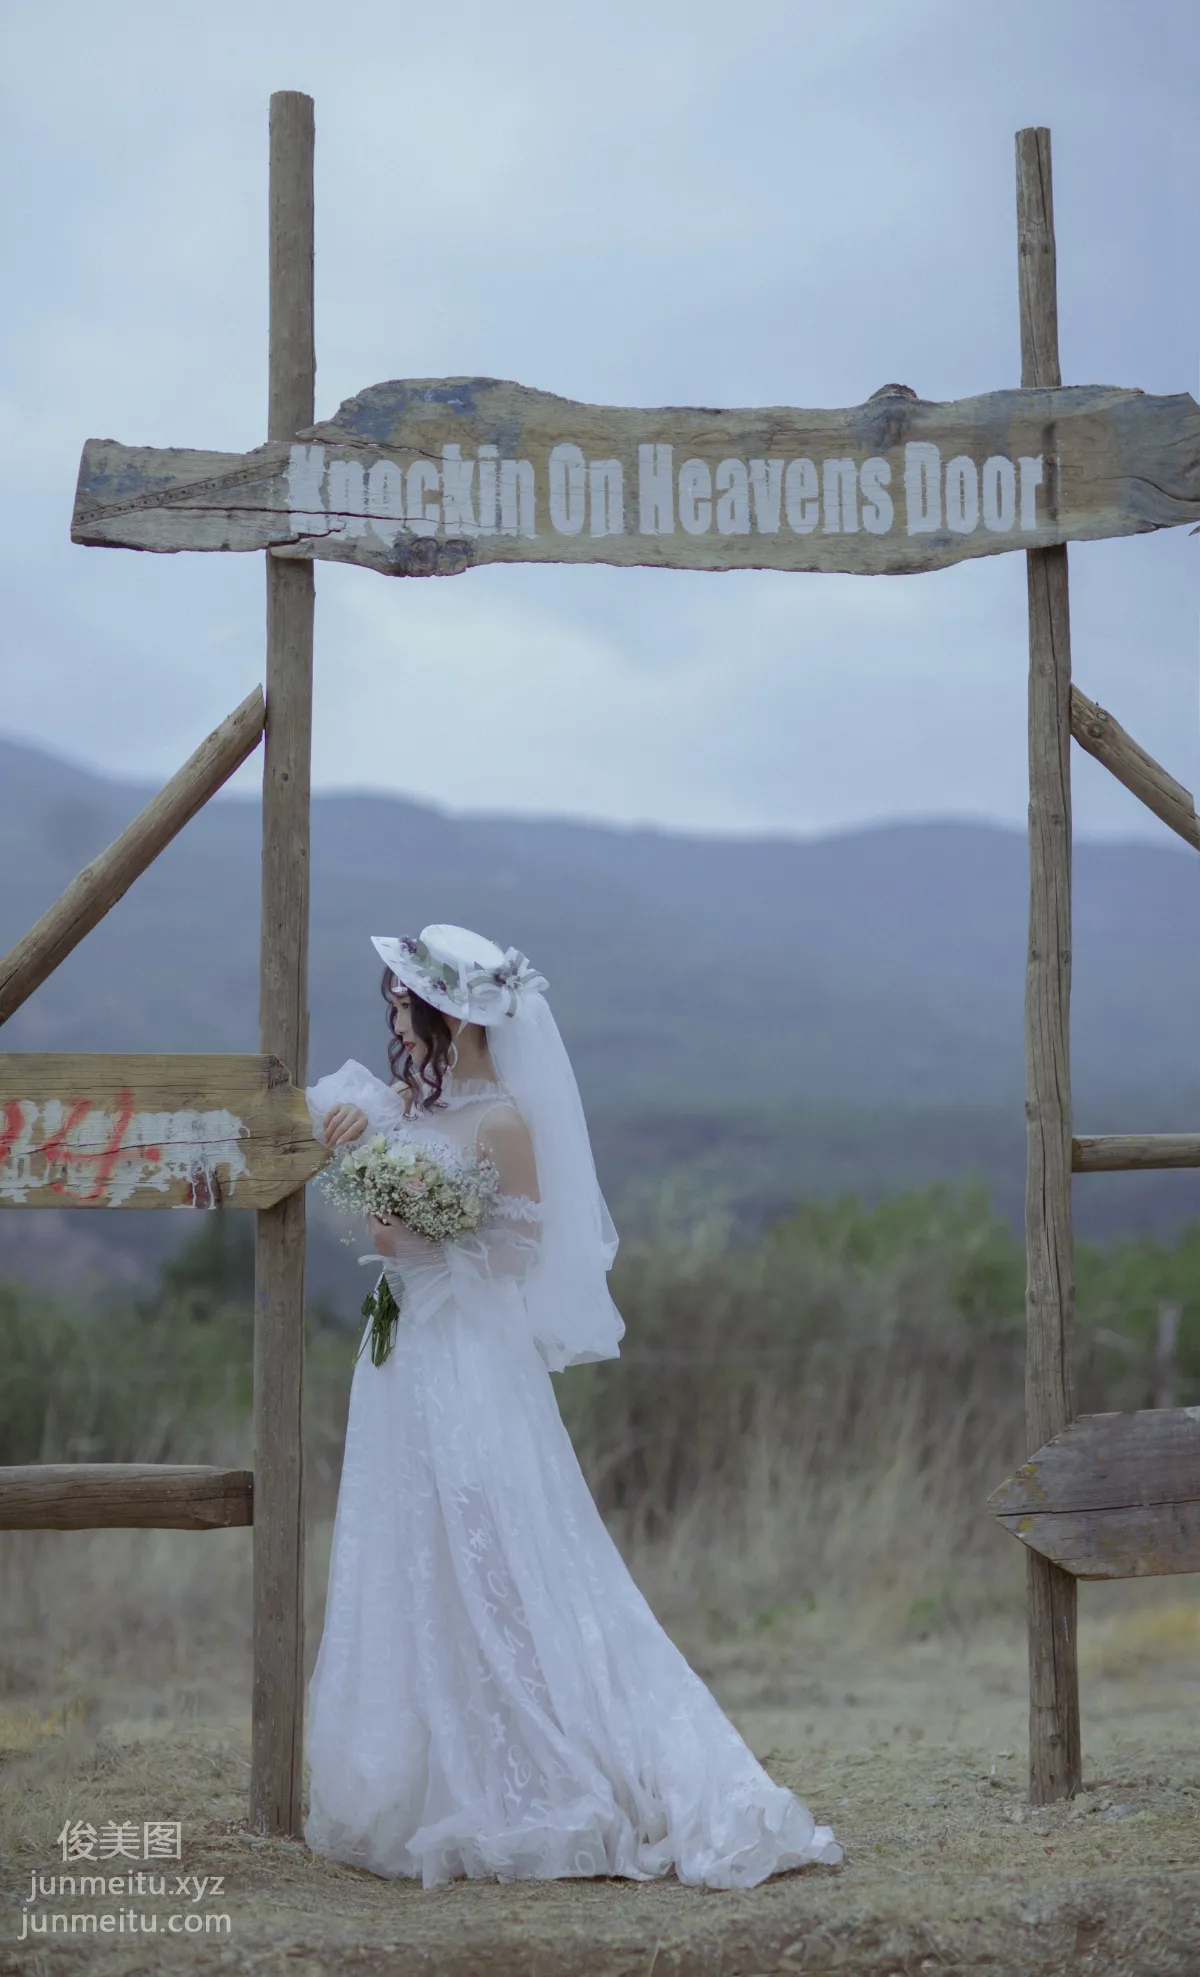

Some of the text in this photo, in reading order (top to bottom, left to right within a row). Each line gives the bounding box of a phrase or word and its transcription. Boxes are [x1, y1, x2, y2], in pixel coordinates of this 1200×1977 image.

[286, 441, 1043, 540] Knockin On Heavens Door
